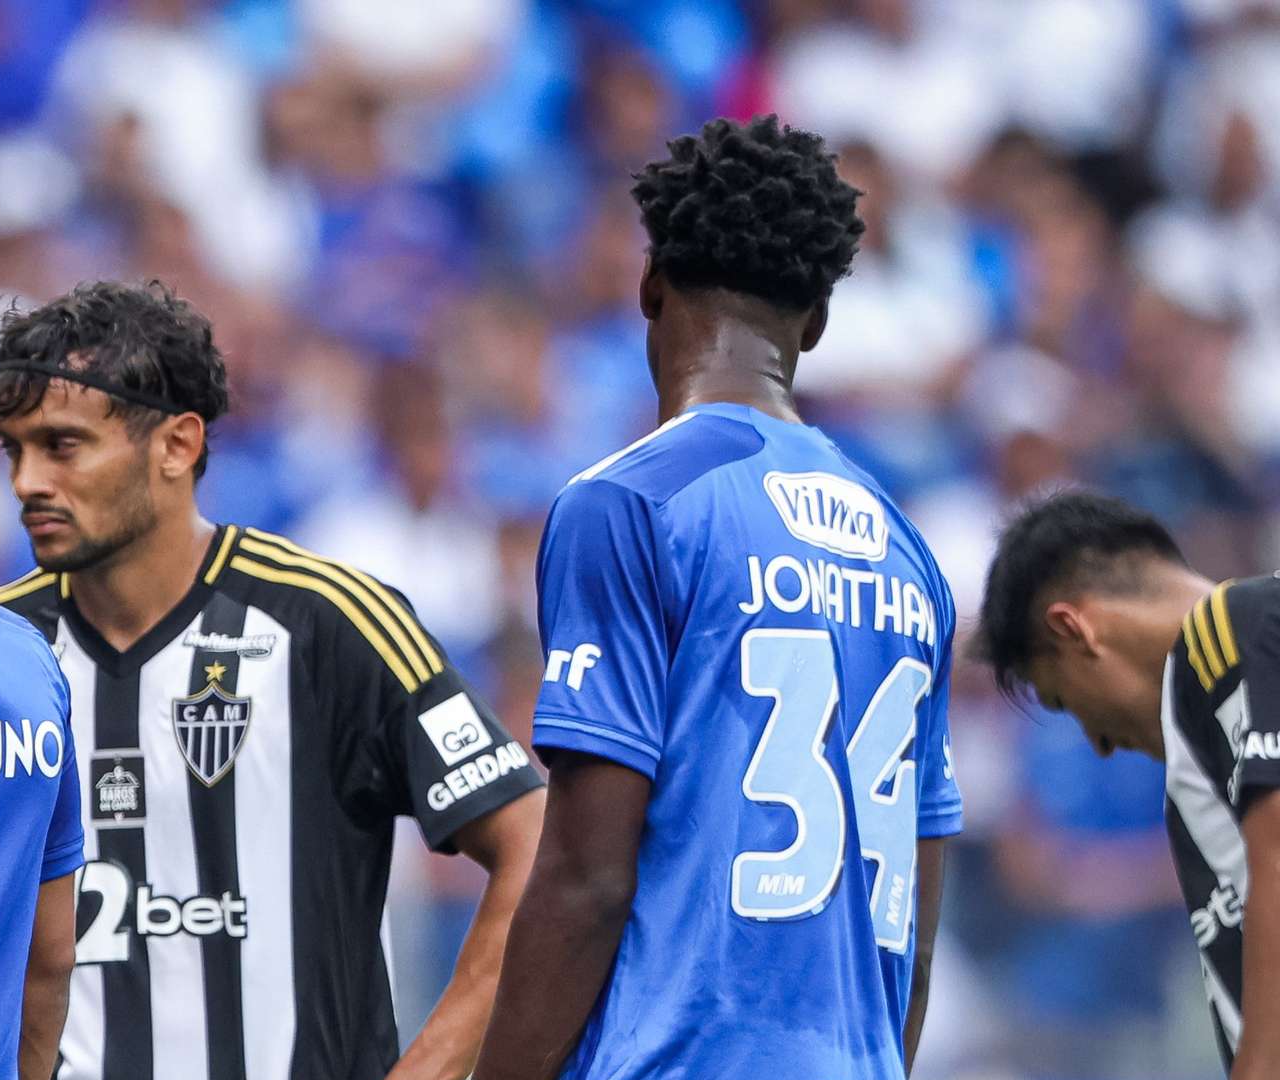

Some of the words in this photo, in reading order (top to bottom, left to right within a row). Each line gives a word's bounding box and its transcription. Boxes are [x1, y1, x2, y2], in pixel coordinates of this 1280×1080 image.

[776, 482, 875, 544] Vilma
[738, 554, 934, 647] JONATHAN
[543, 643, 602, 691] rf
[183, 704, 241, 722] CAM
[427, 741, 530, 811] GERDAU
[732, 628, 931, 955] 34
[75, 860, 247, 965] 2bet
